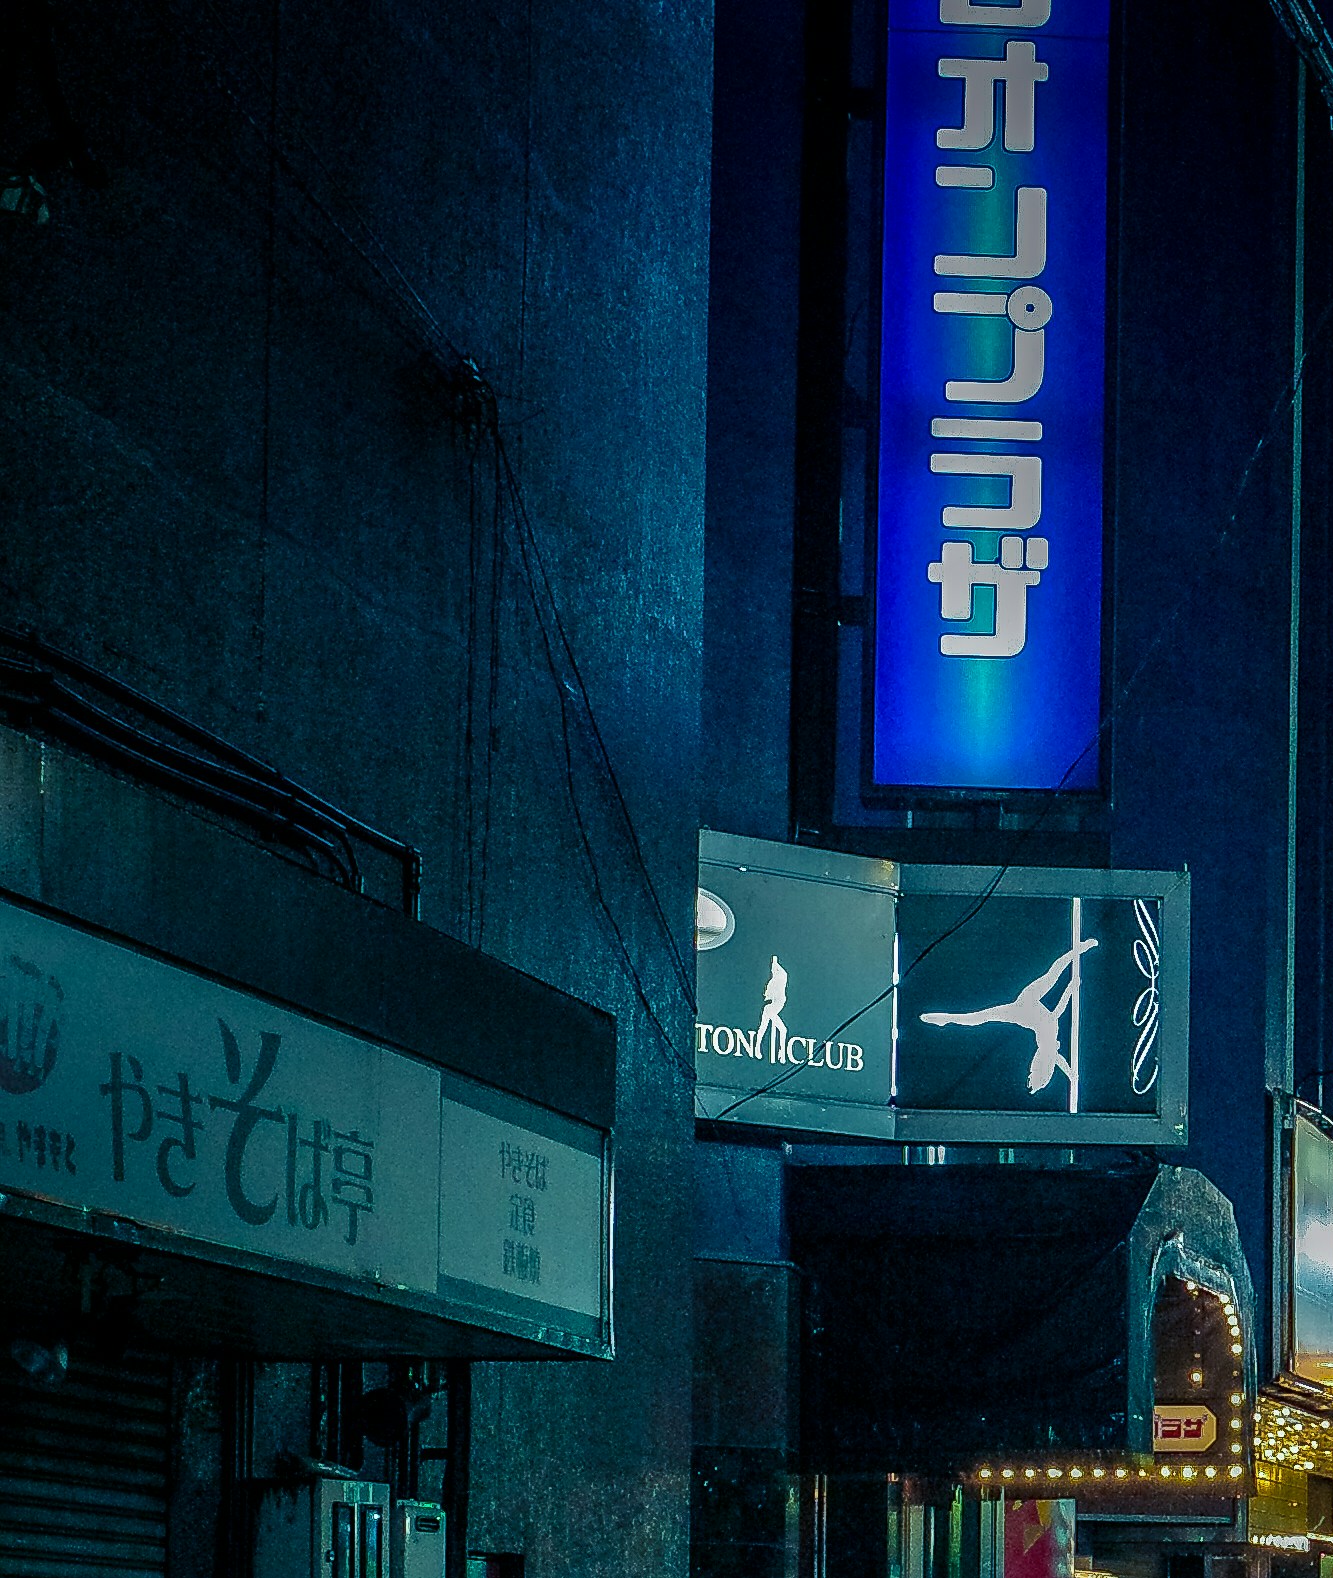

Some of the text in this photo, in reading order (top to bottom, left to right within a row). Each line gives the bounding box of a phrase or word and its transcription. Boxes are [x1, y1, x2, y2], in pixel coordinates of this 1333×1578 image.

[926, 0, 1053, 657] オンプラザ
[99, 1016, 375, 1245] やきそば亭
[786, 1036, 864, 1071] CLUB
